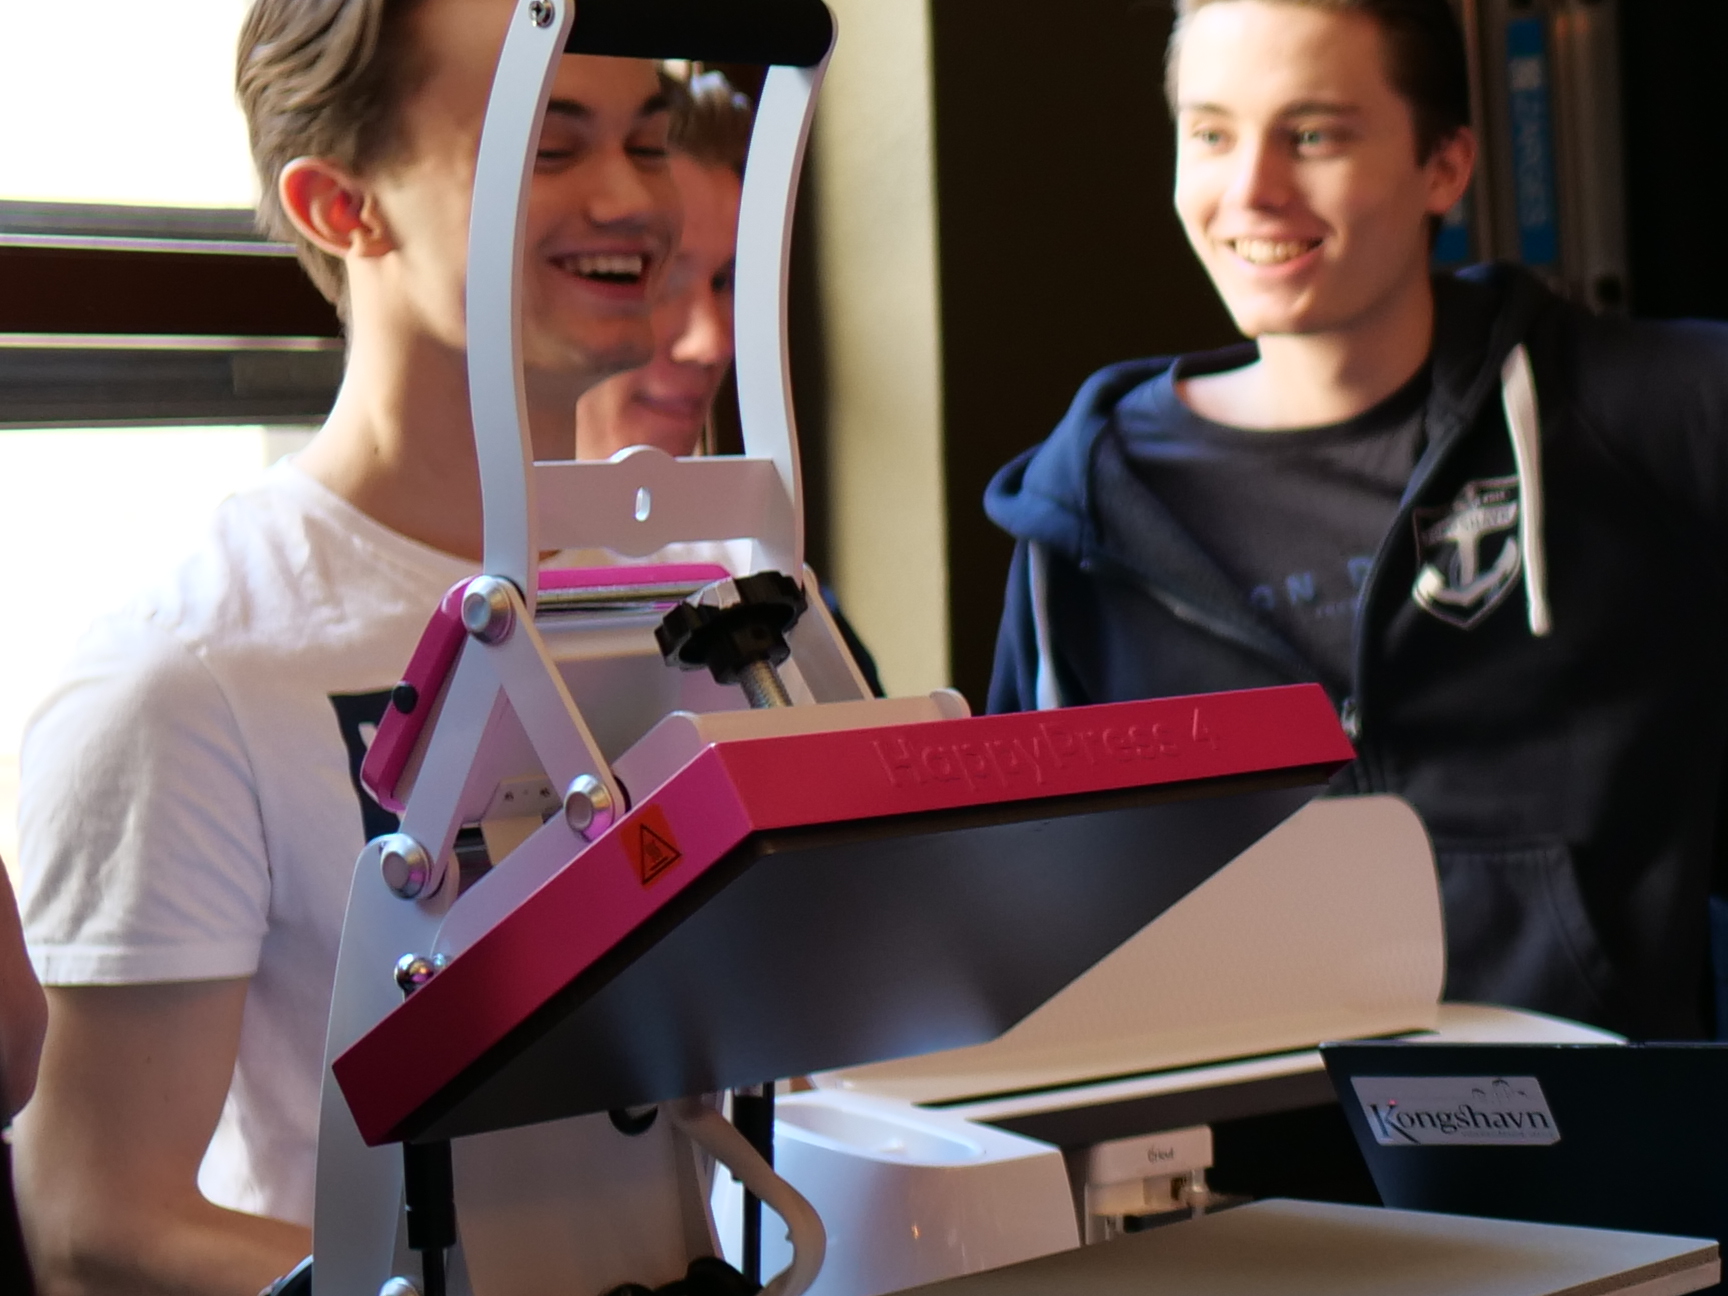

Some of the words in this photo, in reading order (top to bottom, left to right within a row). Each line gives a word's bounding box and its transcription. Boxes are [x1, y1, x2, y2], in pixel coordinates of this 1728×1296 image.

[873, 722, 1178, 791] HappyPress
[1191, 706, 1221, 751] 4
[1367, 1101, 1551, 1145] Kongshavn
